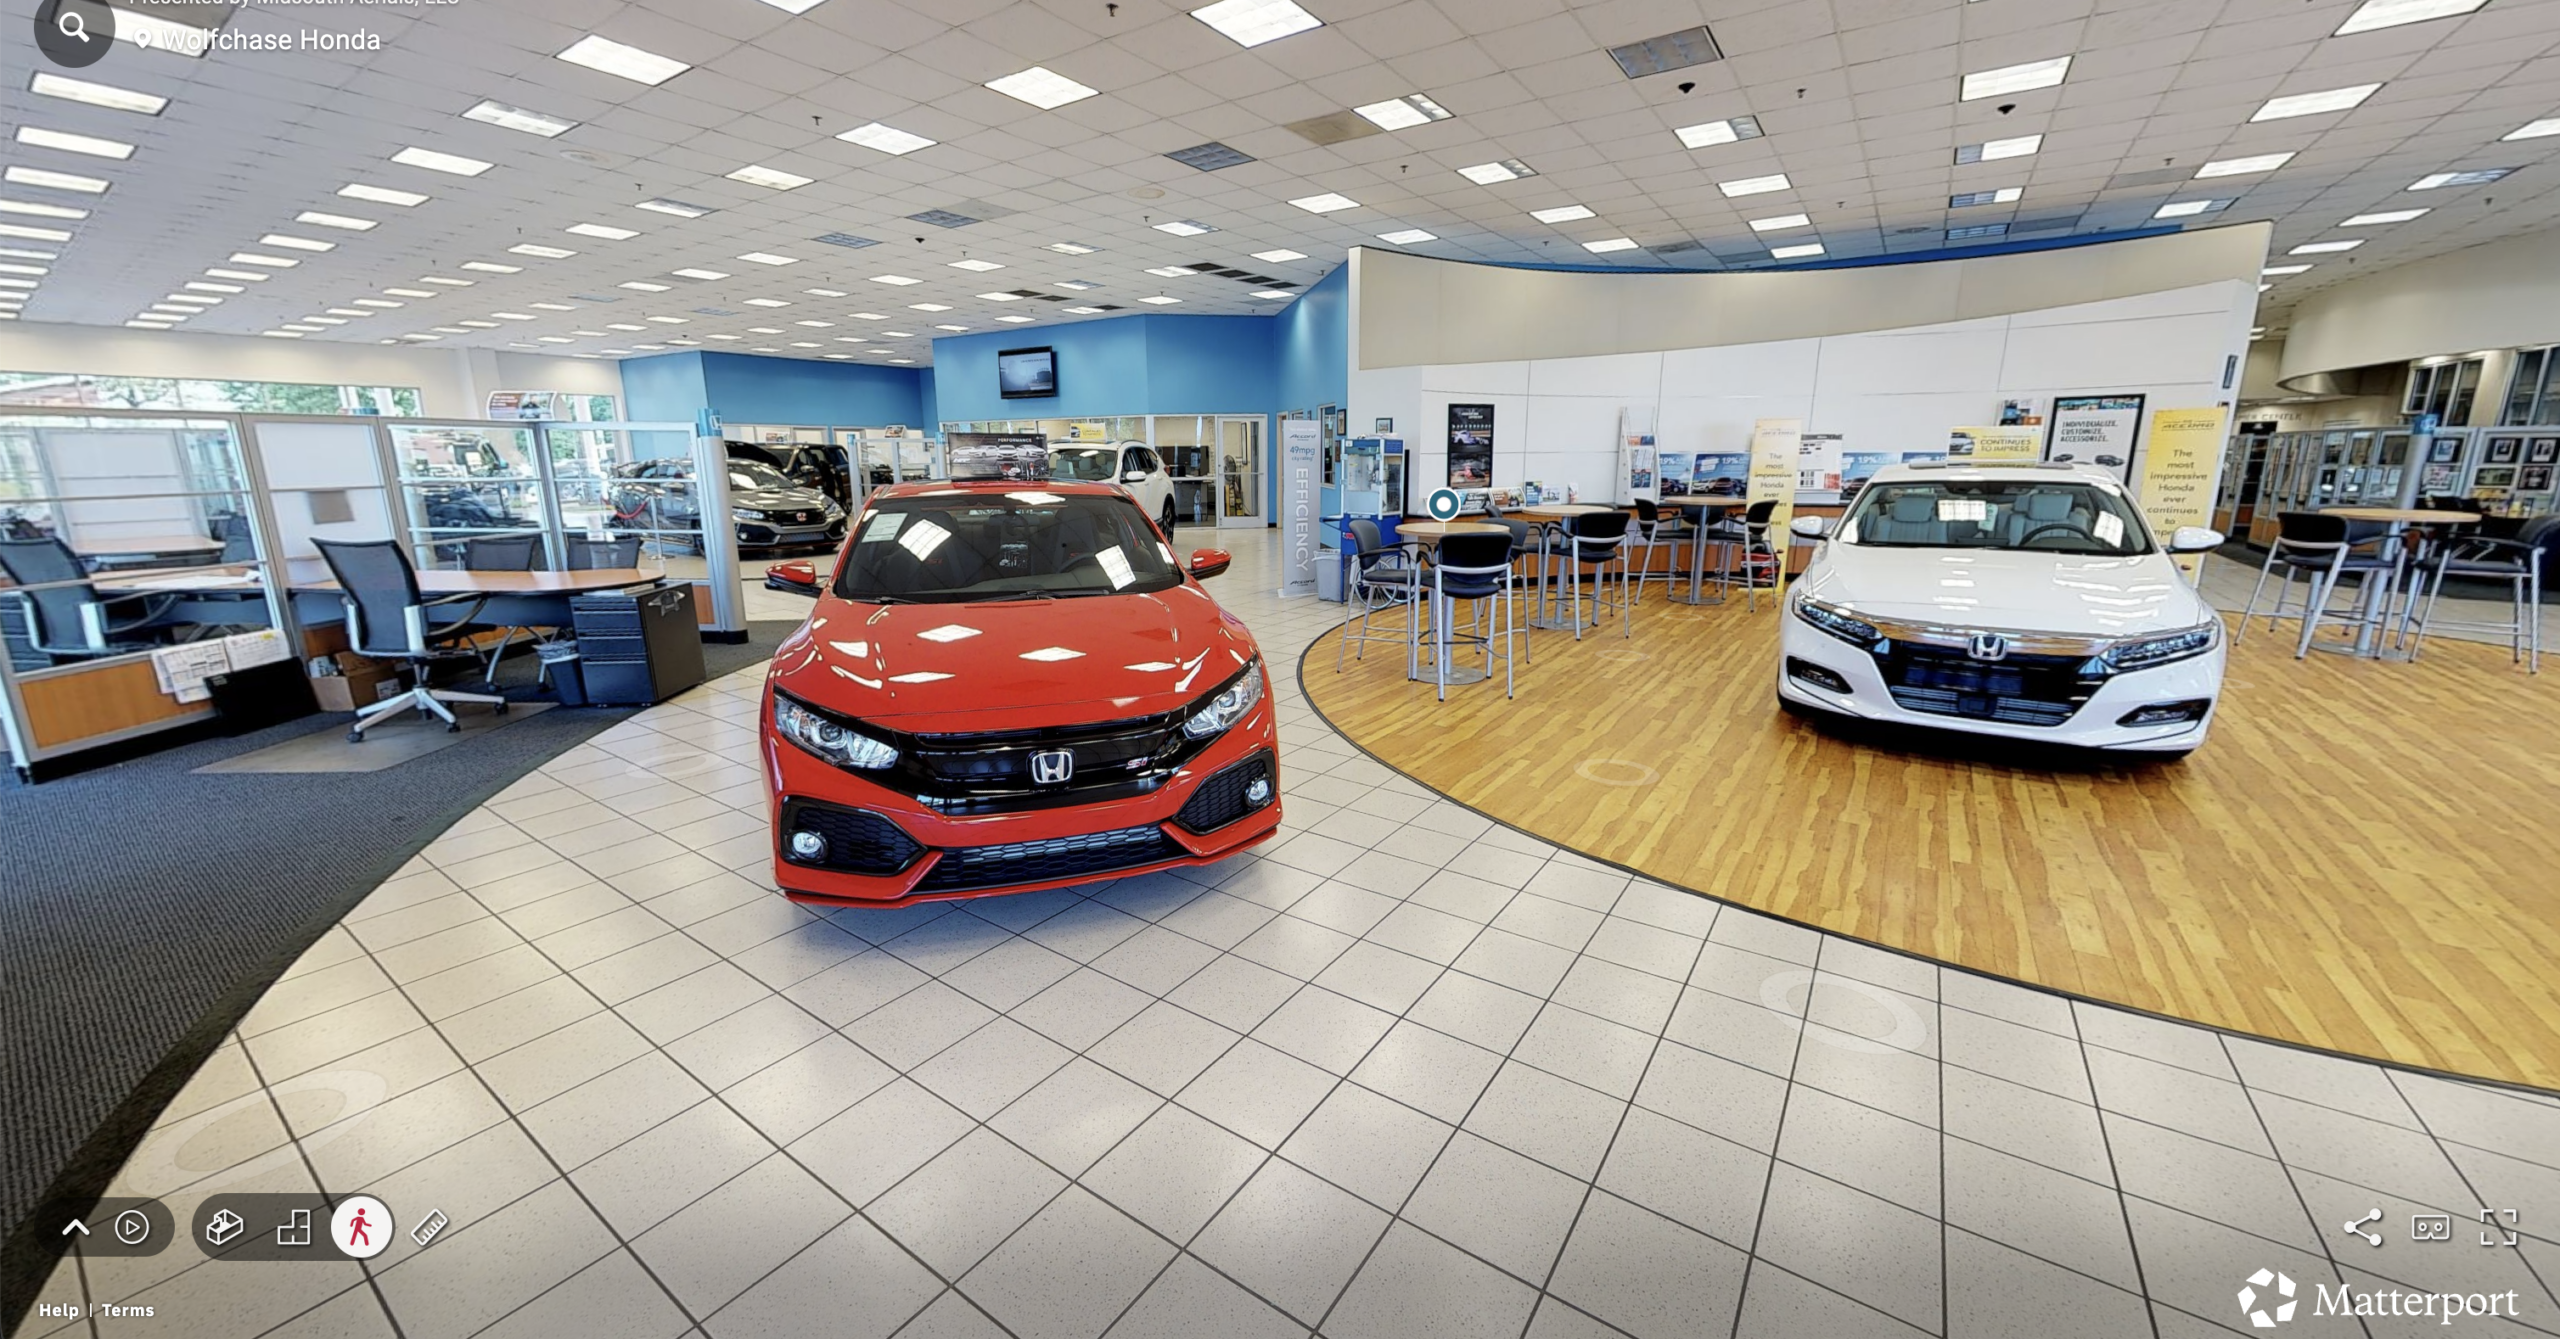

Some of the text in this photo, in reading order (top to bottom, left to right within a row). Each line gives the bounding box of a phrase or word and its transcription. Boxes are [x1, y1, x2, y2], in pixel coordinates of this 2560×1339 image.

[1290, 446, 1315, 456] 49mpg
[2173, 449, 2193, 457] The
[2150, 472, 2208, 481] impressive
[2158, 483, 2195, 492] Honda
[2147, 507, 2198, 515] continues
[1296, 468, 1309, 571] EFFICIENCY
